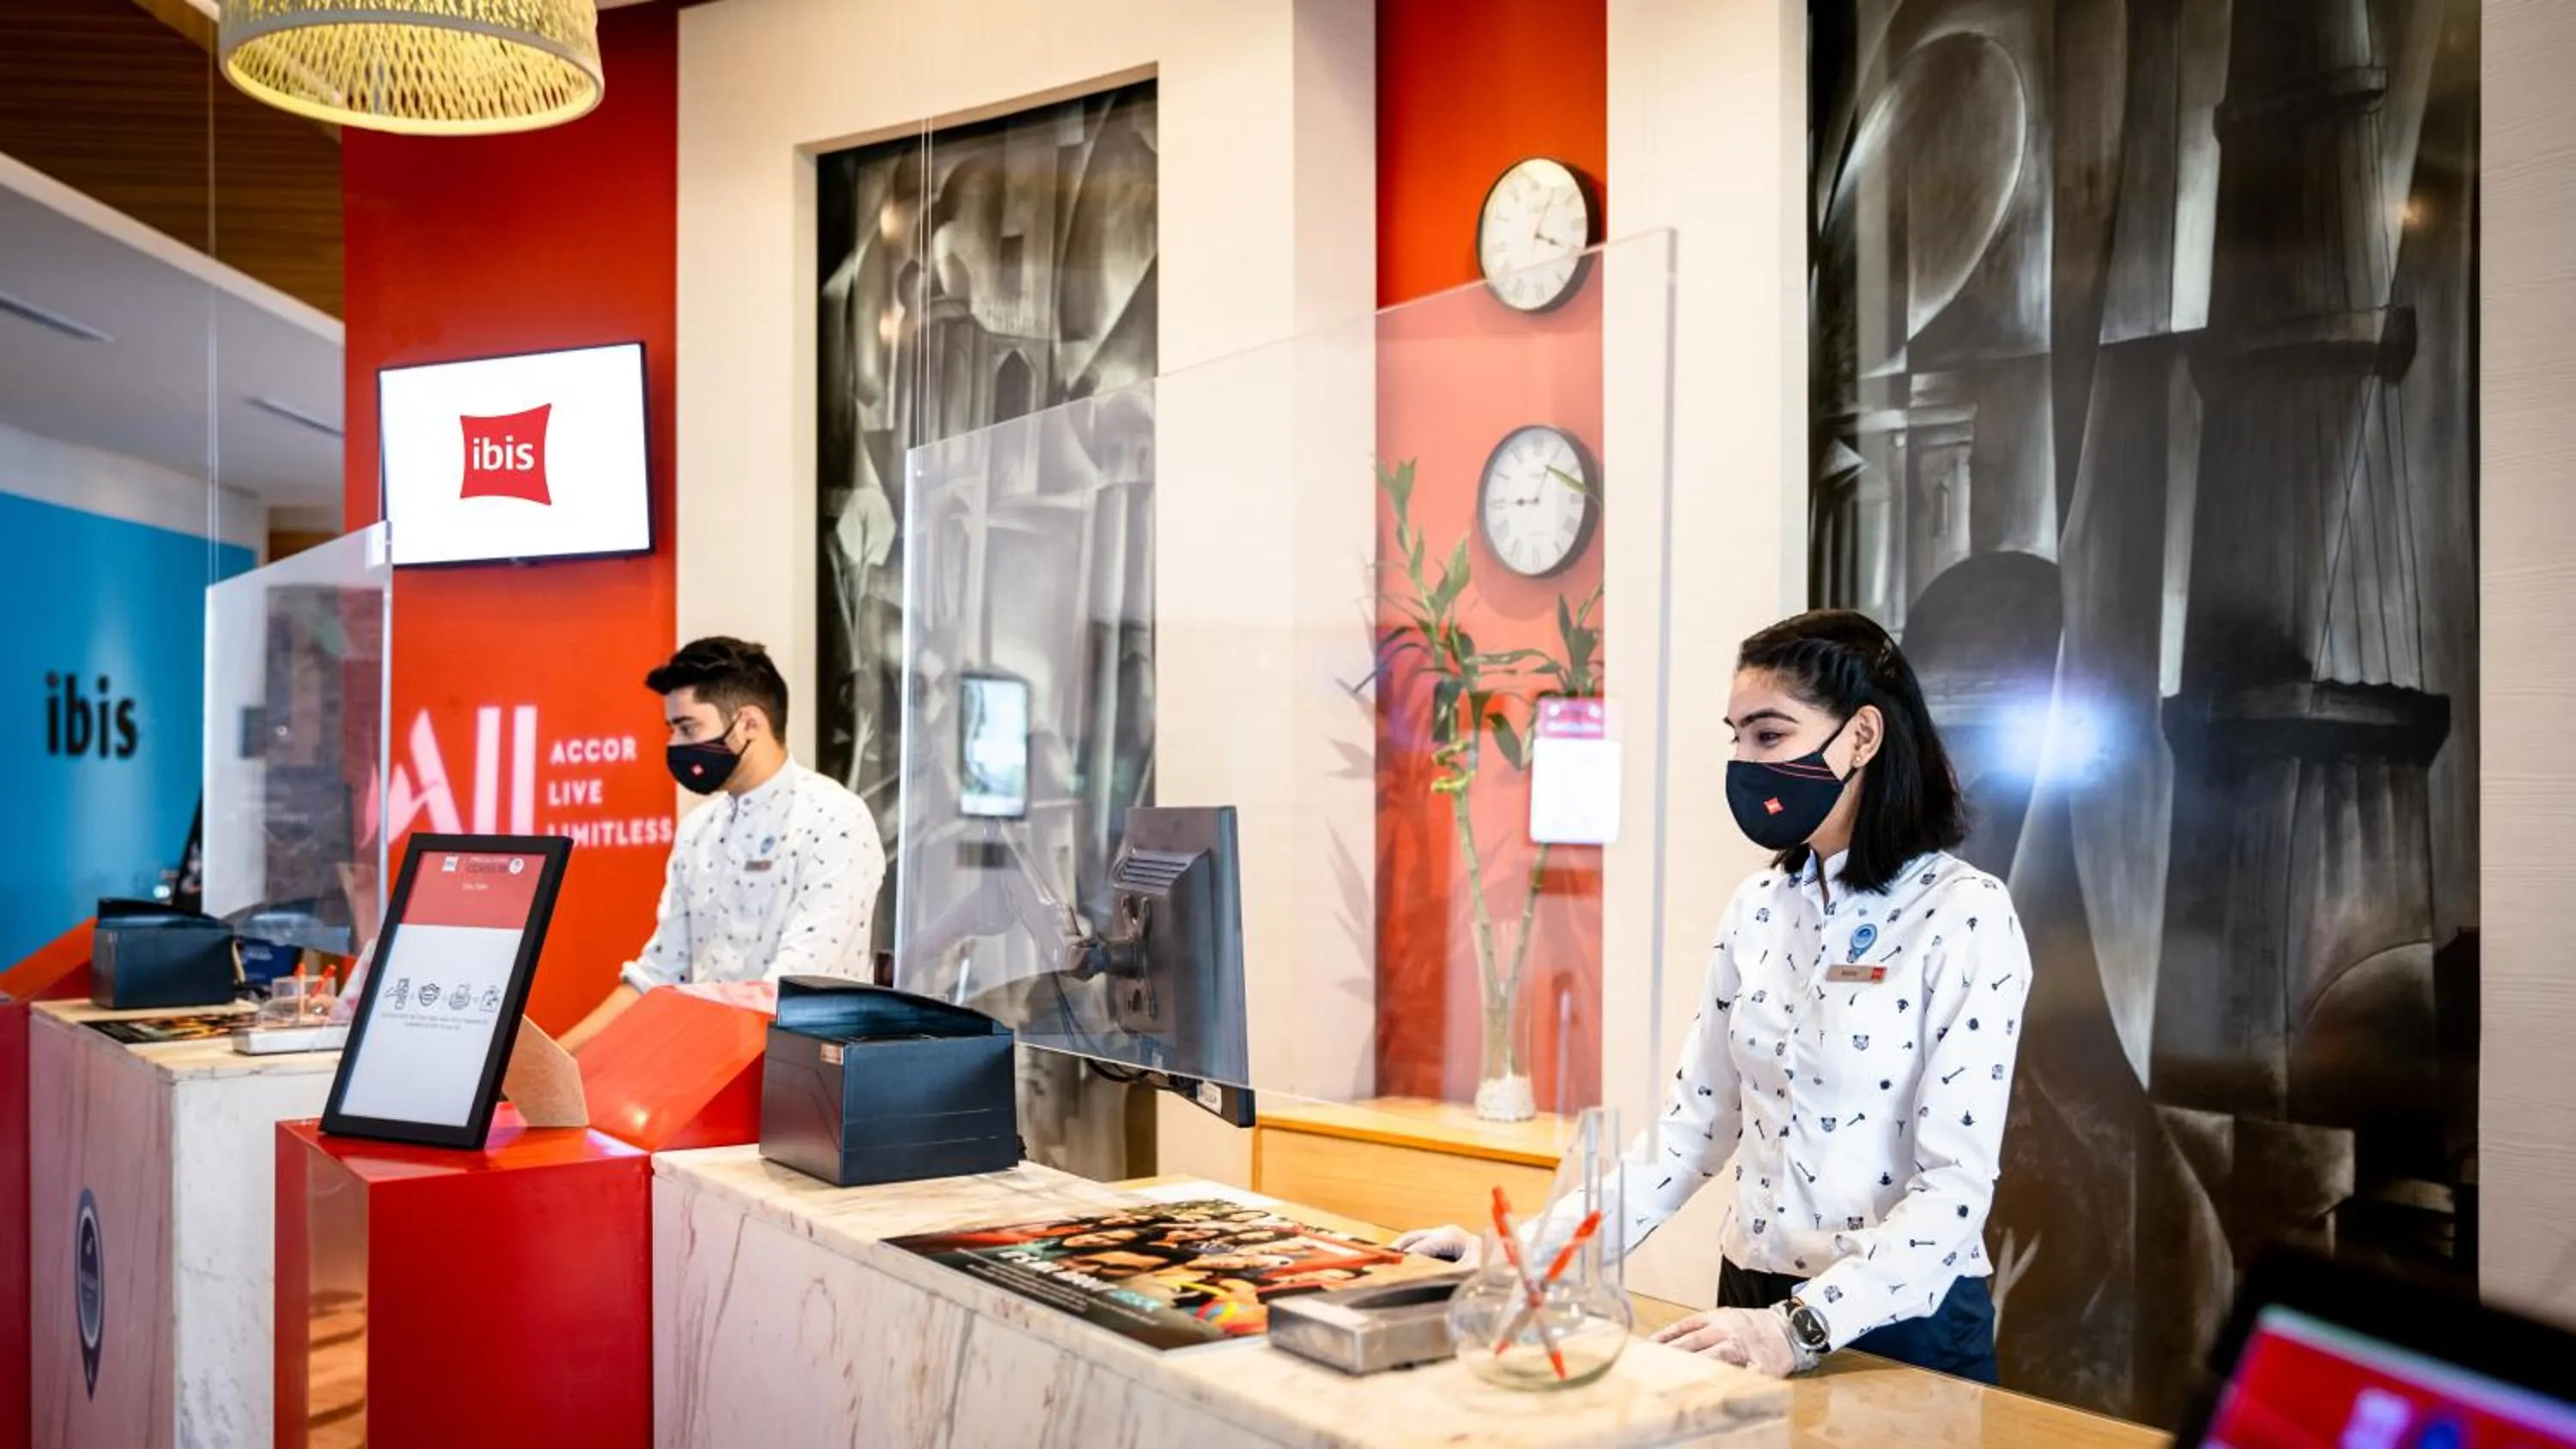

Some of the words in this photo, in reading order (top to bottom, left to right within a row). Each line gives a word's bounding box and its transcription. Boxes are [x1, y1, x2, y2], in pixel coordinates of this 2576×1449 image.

[473, 435, 535, 471] ibis
[46, 670, 138, 759] ibis
[550, 737, 637, 765] ACCOR
[548, 779, 603, 805] LIVE
